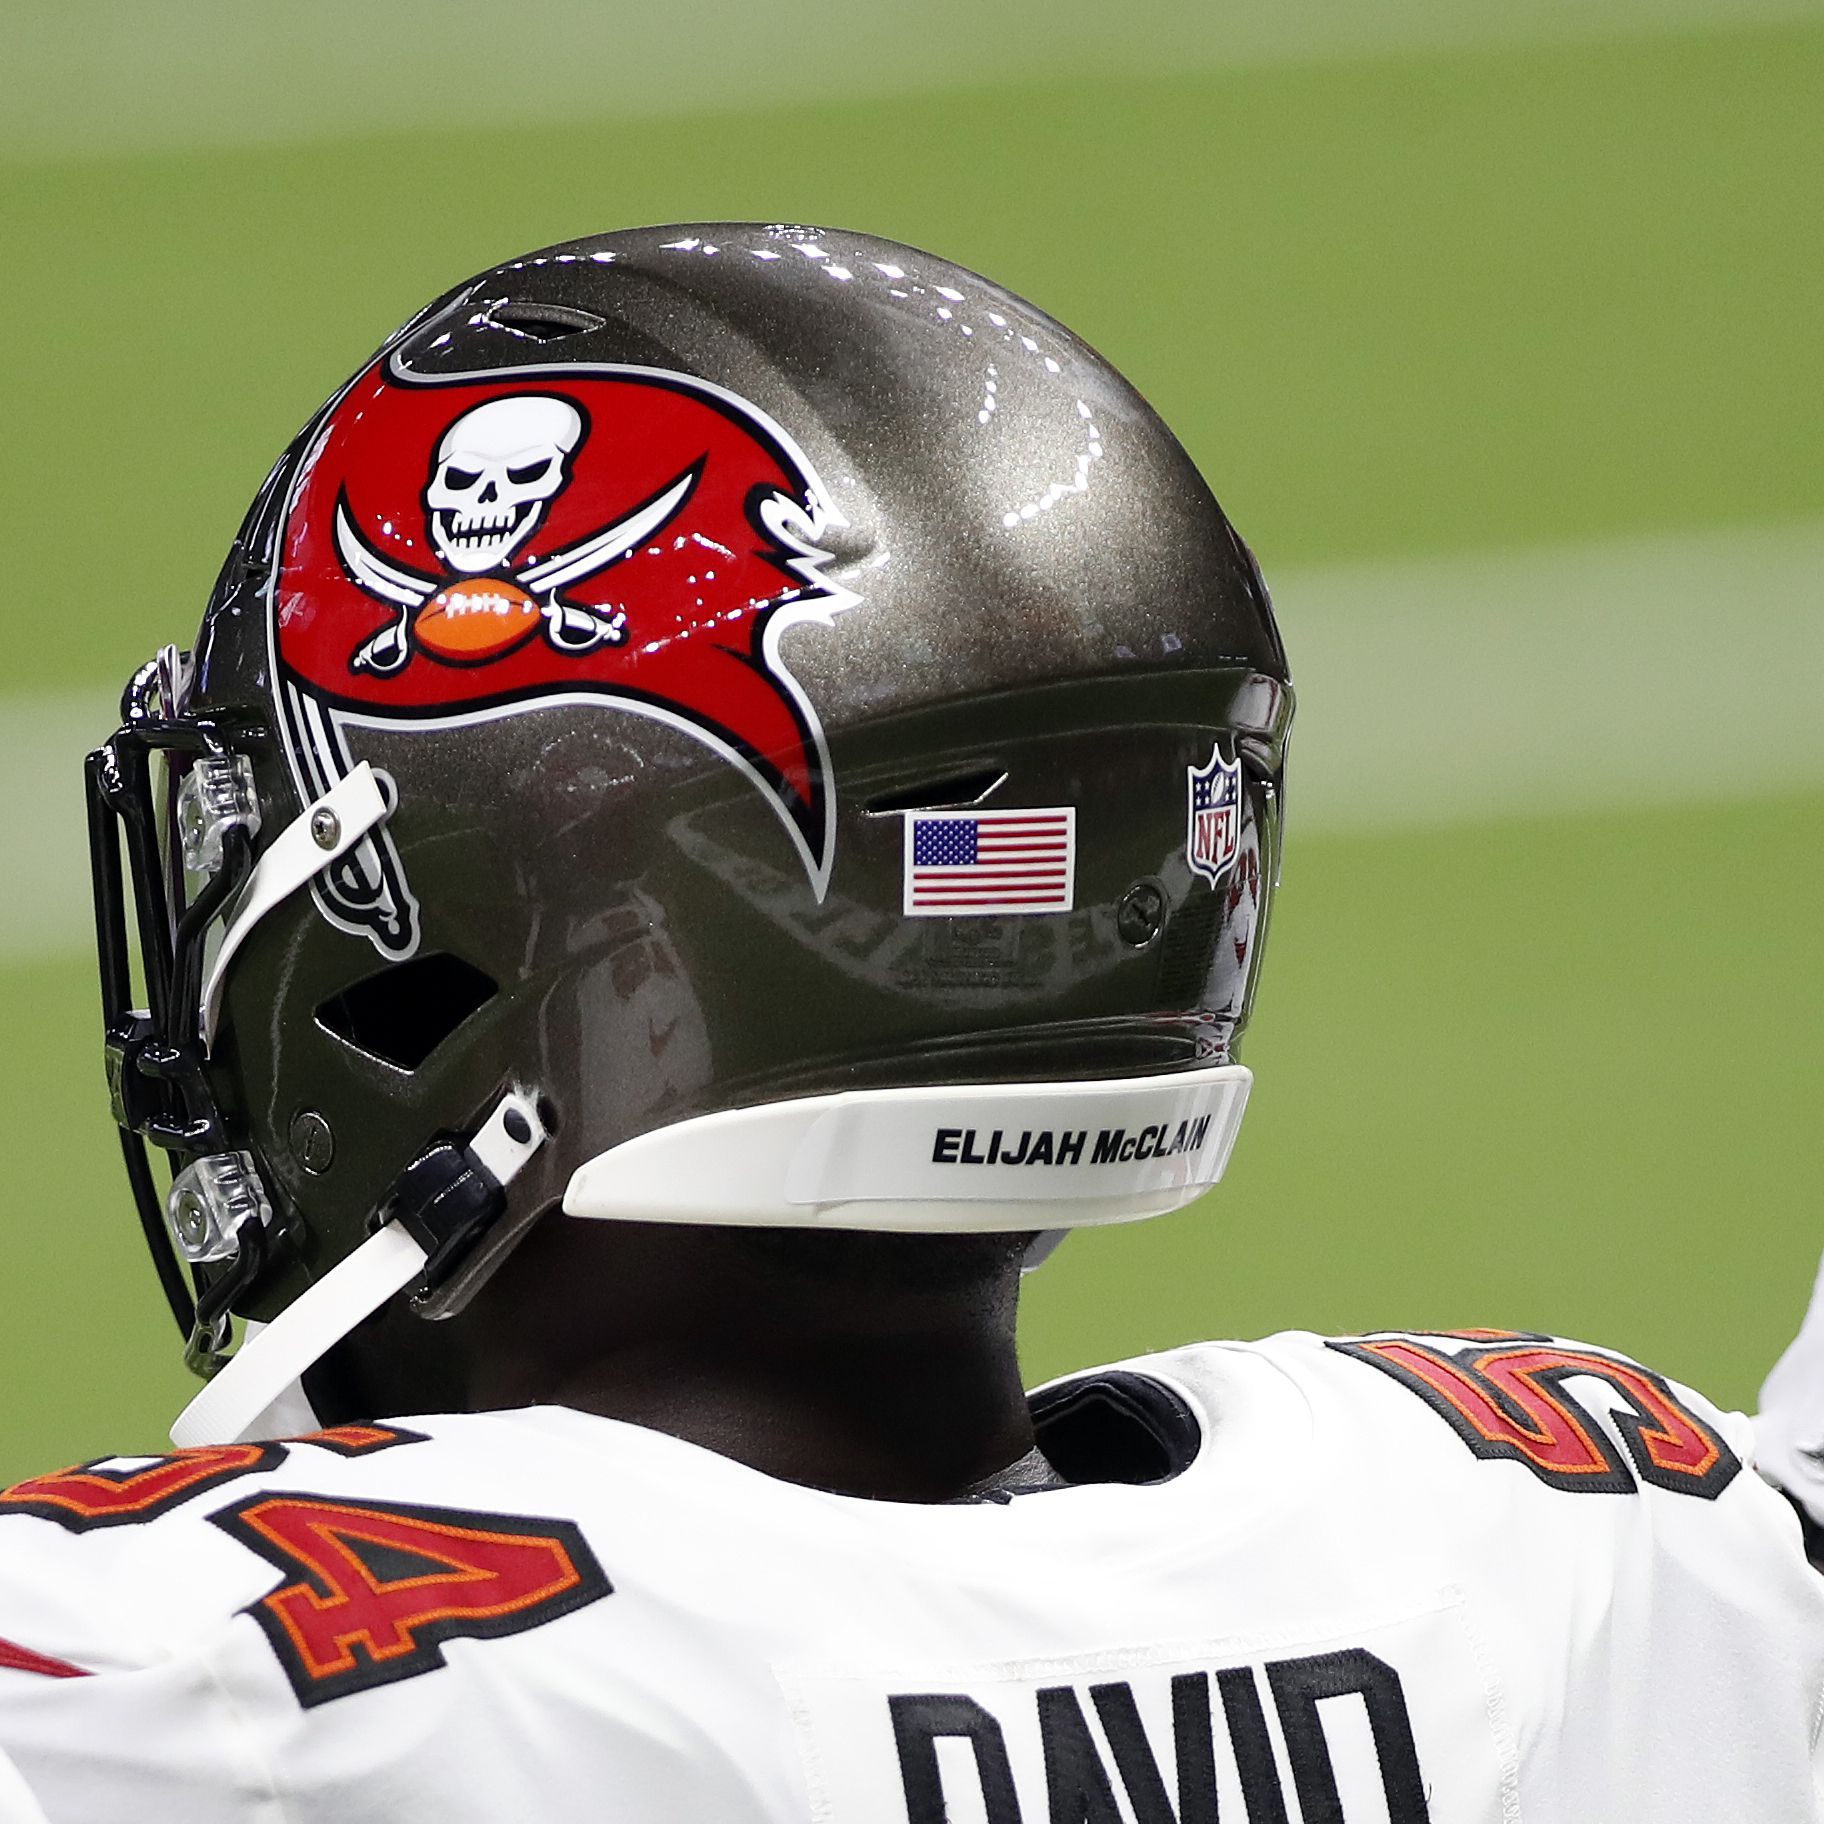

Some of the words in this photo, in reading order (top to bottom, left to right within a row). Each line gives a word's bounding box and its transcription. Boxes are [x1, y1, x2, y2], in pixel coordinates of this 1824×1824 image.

[1192, 807, 1236, 866] NFL
[931, 1128, 1088, 1165] ELIJAH
[1089, 1114, 1212, 1165] McCLAIN
